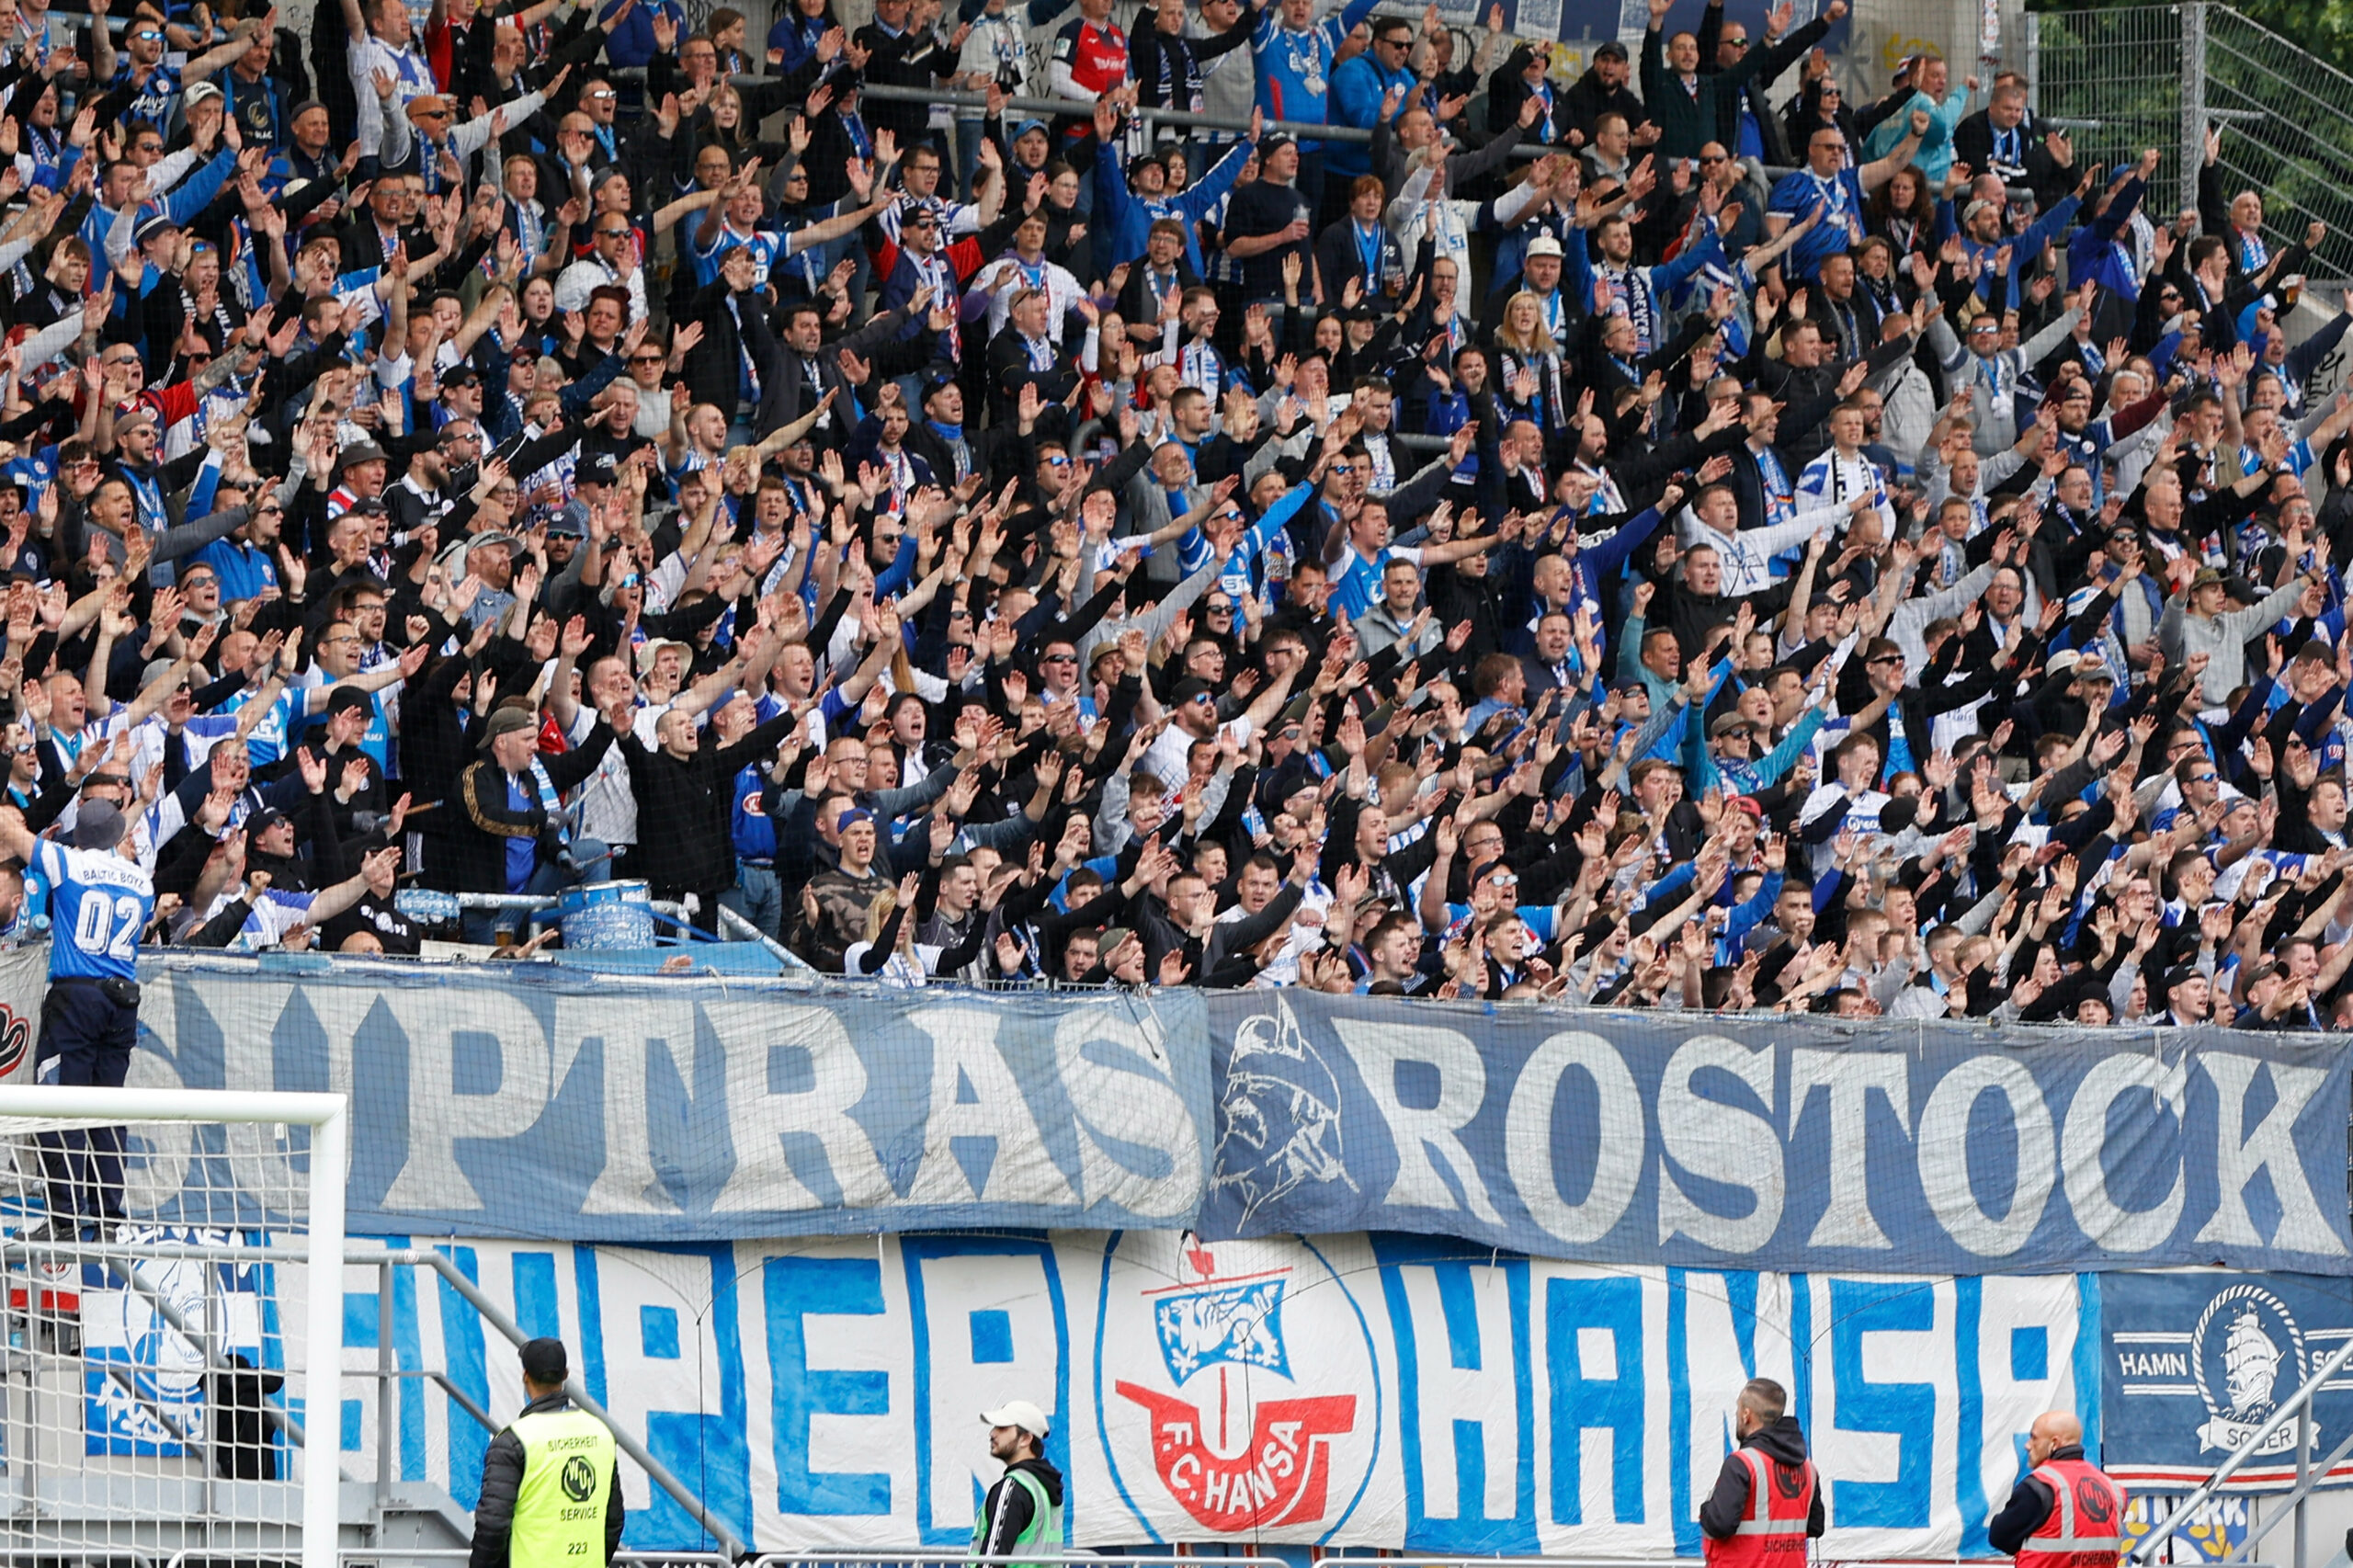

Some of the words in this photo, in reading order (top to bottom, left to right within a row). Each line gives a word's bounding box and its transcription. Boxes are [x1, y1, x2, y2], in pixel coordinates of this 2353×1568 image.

[84, 869, 118, 881] BALTIC
[74, 889, 143, 962] 02
[1329, 1017, 2352, 1256] ROSTOCK
[2118, 1352, 2188, 1377] HAMN
[1399, 1265, 2079, 1529] HANSA
[547, 1436, 597, 1451] SICHERHEIT
[560, 1506, 598, 1522] SERVICE
[566, 1542, 588, 1556] 223
